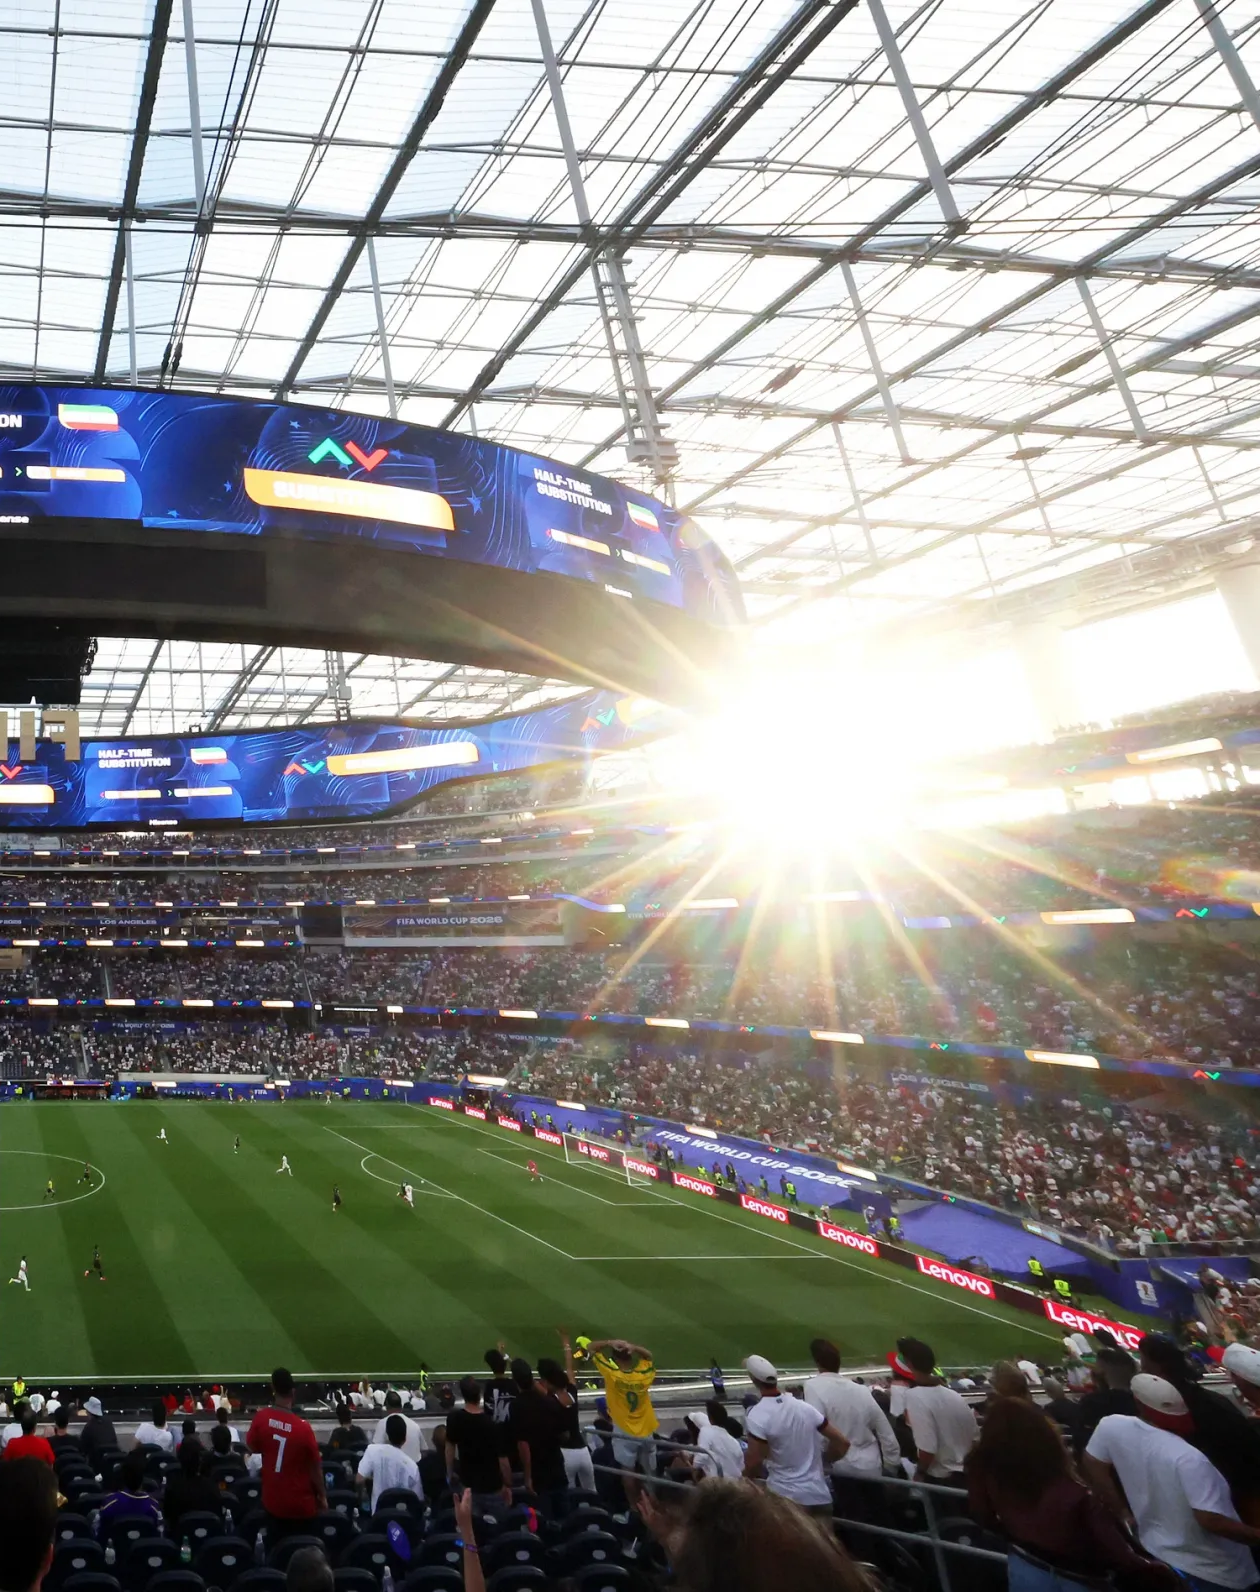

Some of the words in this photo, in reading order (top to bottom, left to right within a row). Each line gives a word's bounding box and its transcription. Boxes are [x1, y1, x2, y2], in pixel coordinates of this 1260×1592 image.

[533, 468, 593, 496] HALF-TIME
[536, 482, 613, 516] SUBSTITUTION
[98, 748, 153, 758] HALF-TIME
[98, 758, 171, 768] SUBSTITUTION
[416, 917, 448, 925] WORLD
[470, 916, 503, 924] 2026
[430, 1097, 453, 1110] Lenovo
[465, 1106, 486, 1120] Lenovo
[498, 1117, 521, 1131] Lenovo
[535, 1129, 561, 1145] Lenovo
[656, 1130, 690, 1144] FIFA
[691, 1139, 753, 1161] WORLD
[750, 1155, 790, 1170] CUP
[623, 1156, 657, 1177] Lenovo
[674, 1173, 714, 1196] Lenovo
[741, 1196, 787, 1222] Lenovo
[819, 1222, 875, 1254] Lenovo
[918, 1257, 990, 1296] Lenovo
[626, 1391, 638, 1412] 9
[273, 1434, 287, 1472] 7
